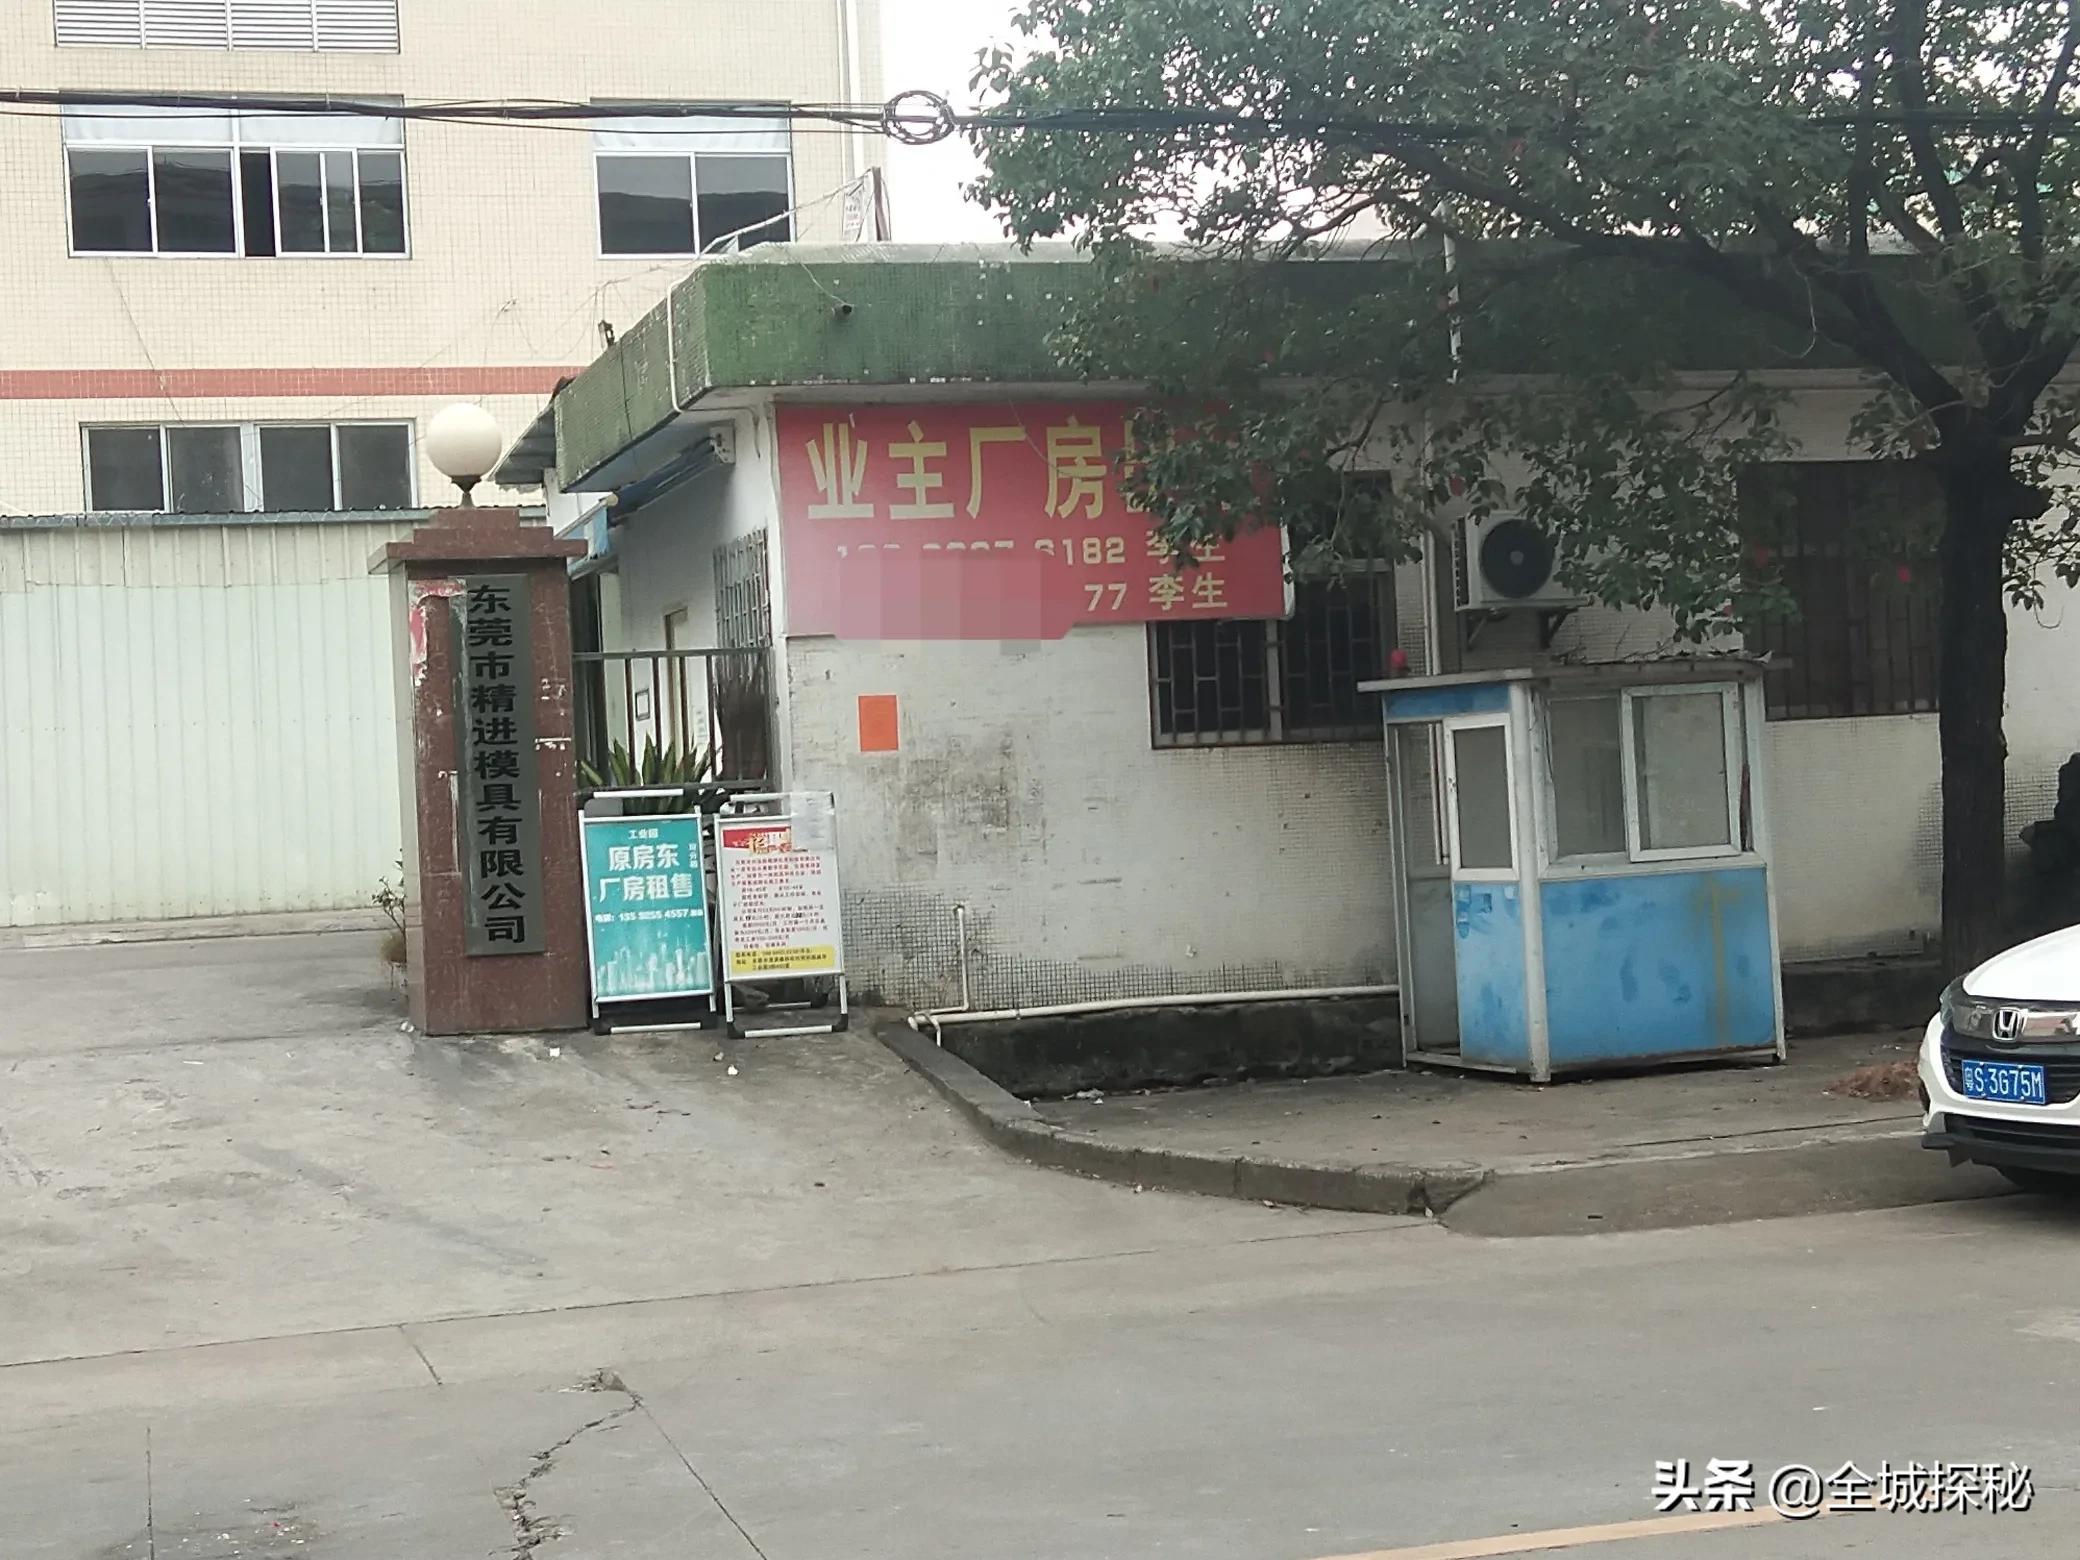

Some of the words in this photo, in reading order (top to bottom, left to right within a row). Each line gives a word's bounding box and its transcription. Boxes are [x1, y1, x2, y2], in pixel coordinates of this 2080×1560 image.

[806, 416, 1185, 520] 业主厂房
[1147, 572, 1228, 611] 李生
[468, 584, 526, 944] 东莞市精进模具有限公司
[609, 843, 680, 872] 原房东
[599, 873, 693, 903] 厂房租售
